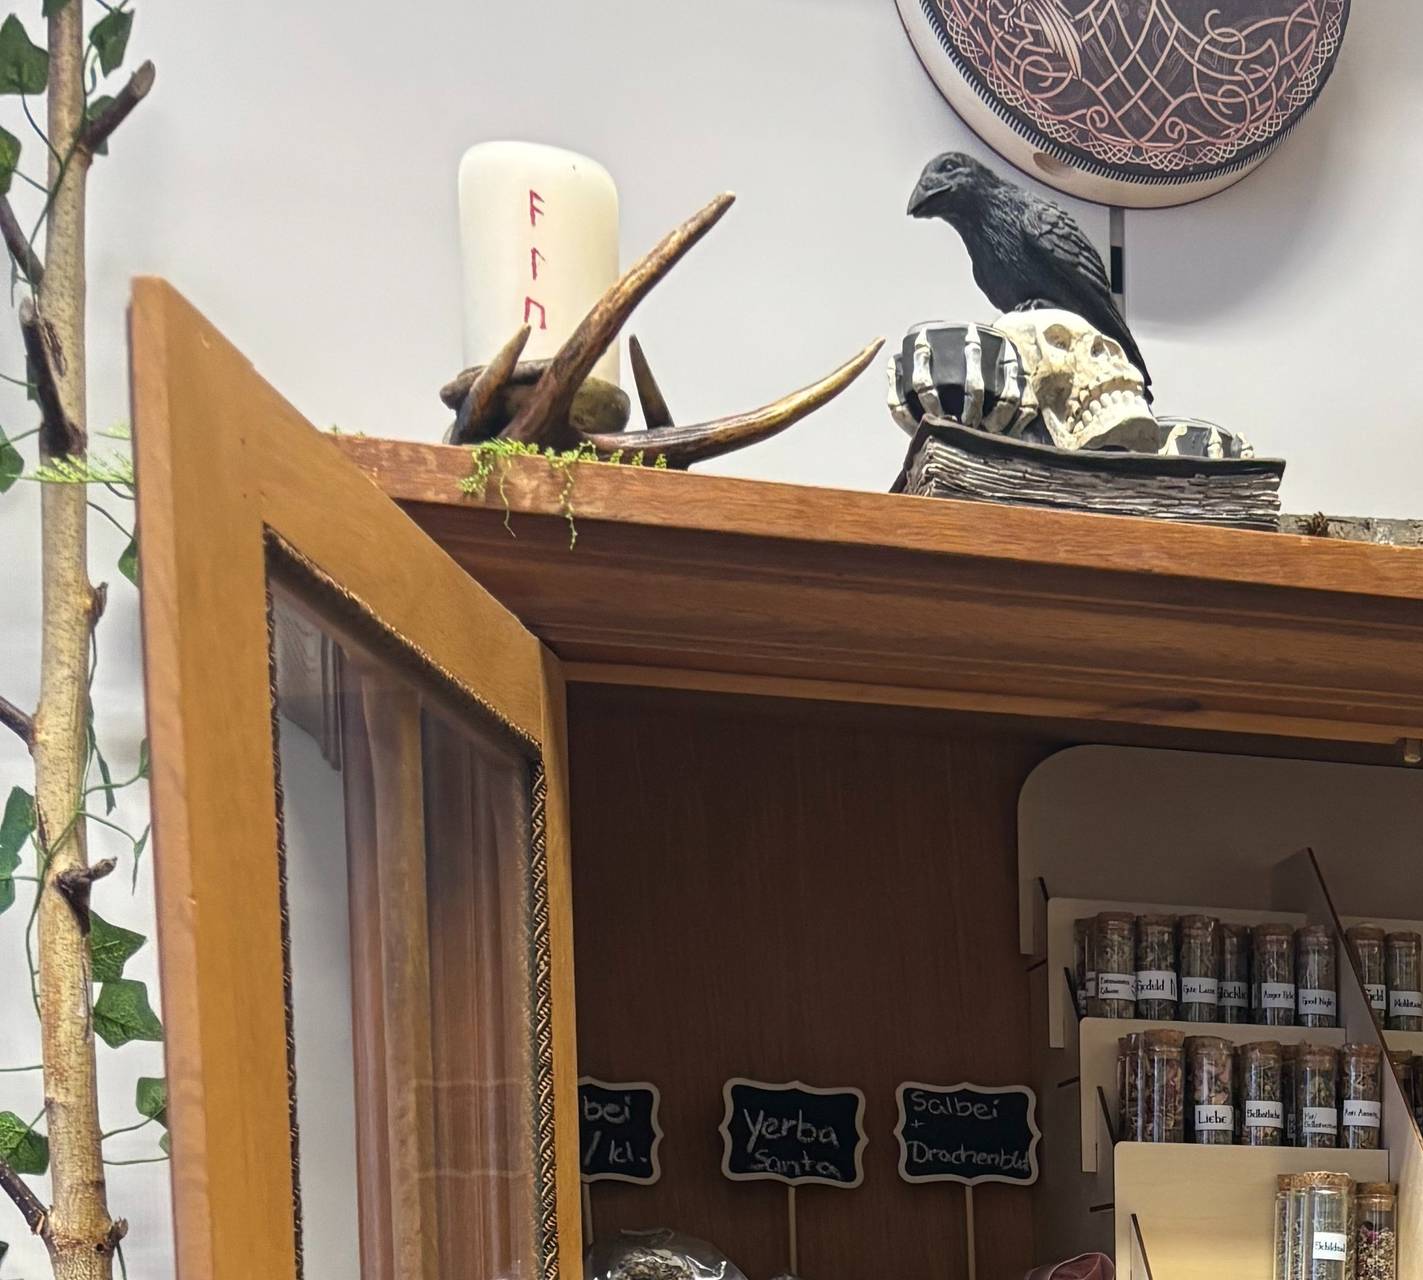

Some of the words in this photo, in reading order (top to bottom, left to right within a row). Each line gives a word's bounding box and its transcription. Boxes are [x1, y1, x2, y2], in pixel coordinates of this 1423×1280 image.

[911, 1091, 999, 1120] Salbei
[1197, 1110, 1227, 1124] Liebe
[743, 1108, 840, 1153] Yerba
[750, 1149, 841, 1179] Santa
